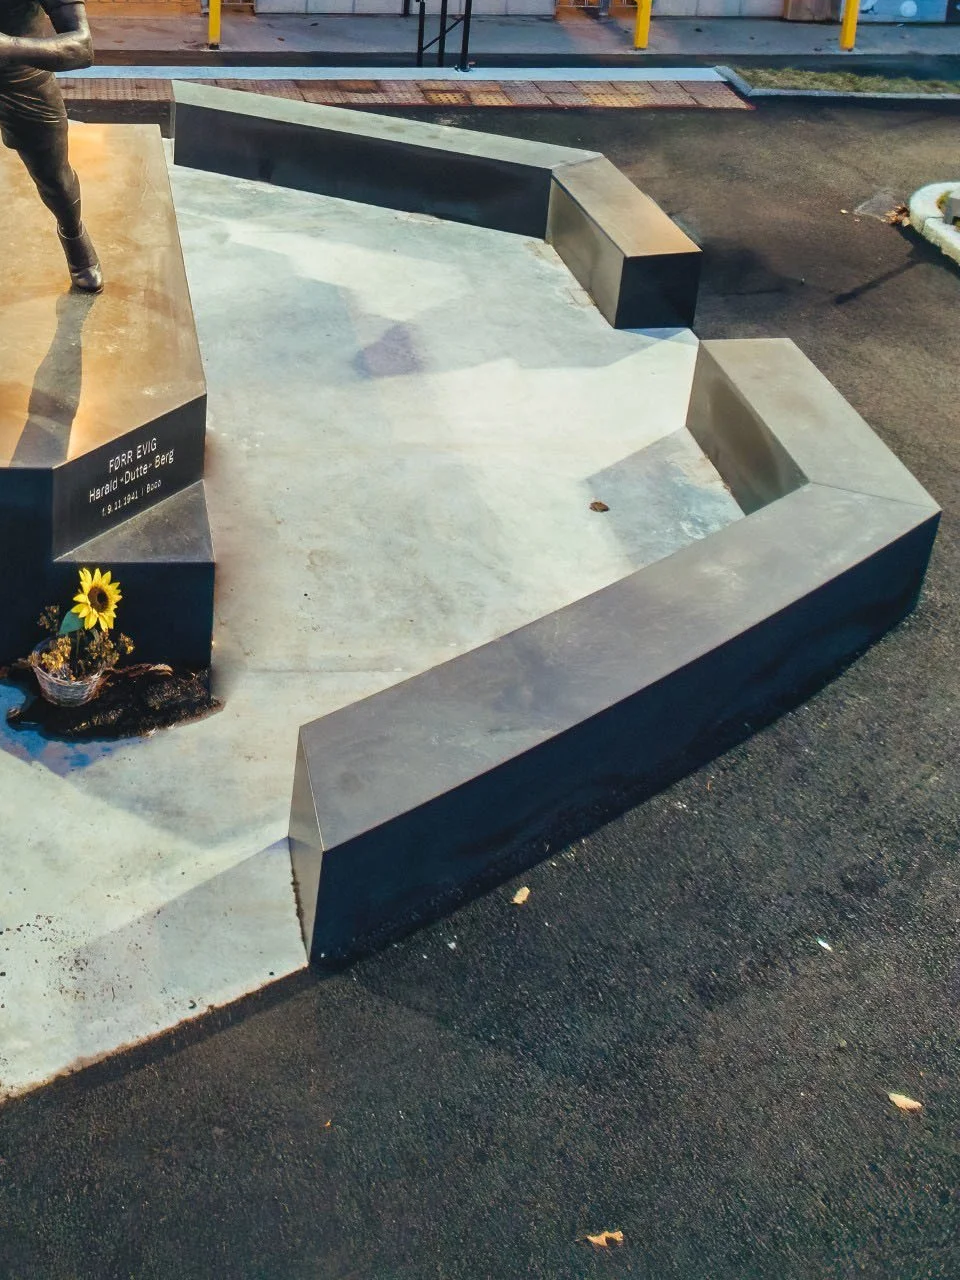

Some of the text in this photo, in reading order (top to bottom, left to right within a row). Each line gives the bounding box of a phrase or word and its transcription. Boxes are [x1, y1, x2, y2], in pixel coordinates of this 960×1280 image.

[89, 479, 118, 503] Harald
[154, 448, 175, 469] Berg
[109, 438, 157, 473] FØRR EVIG
